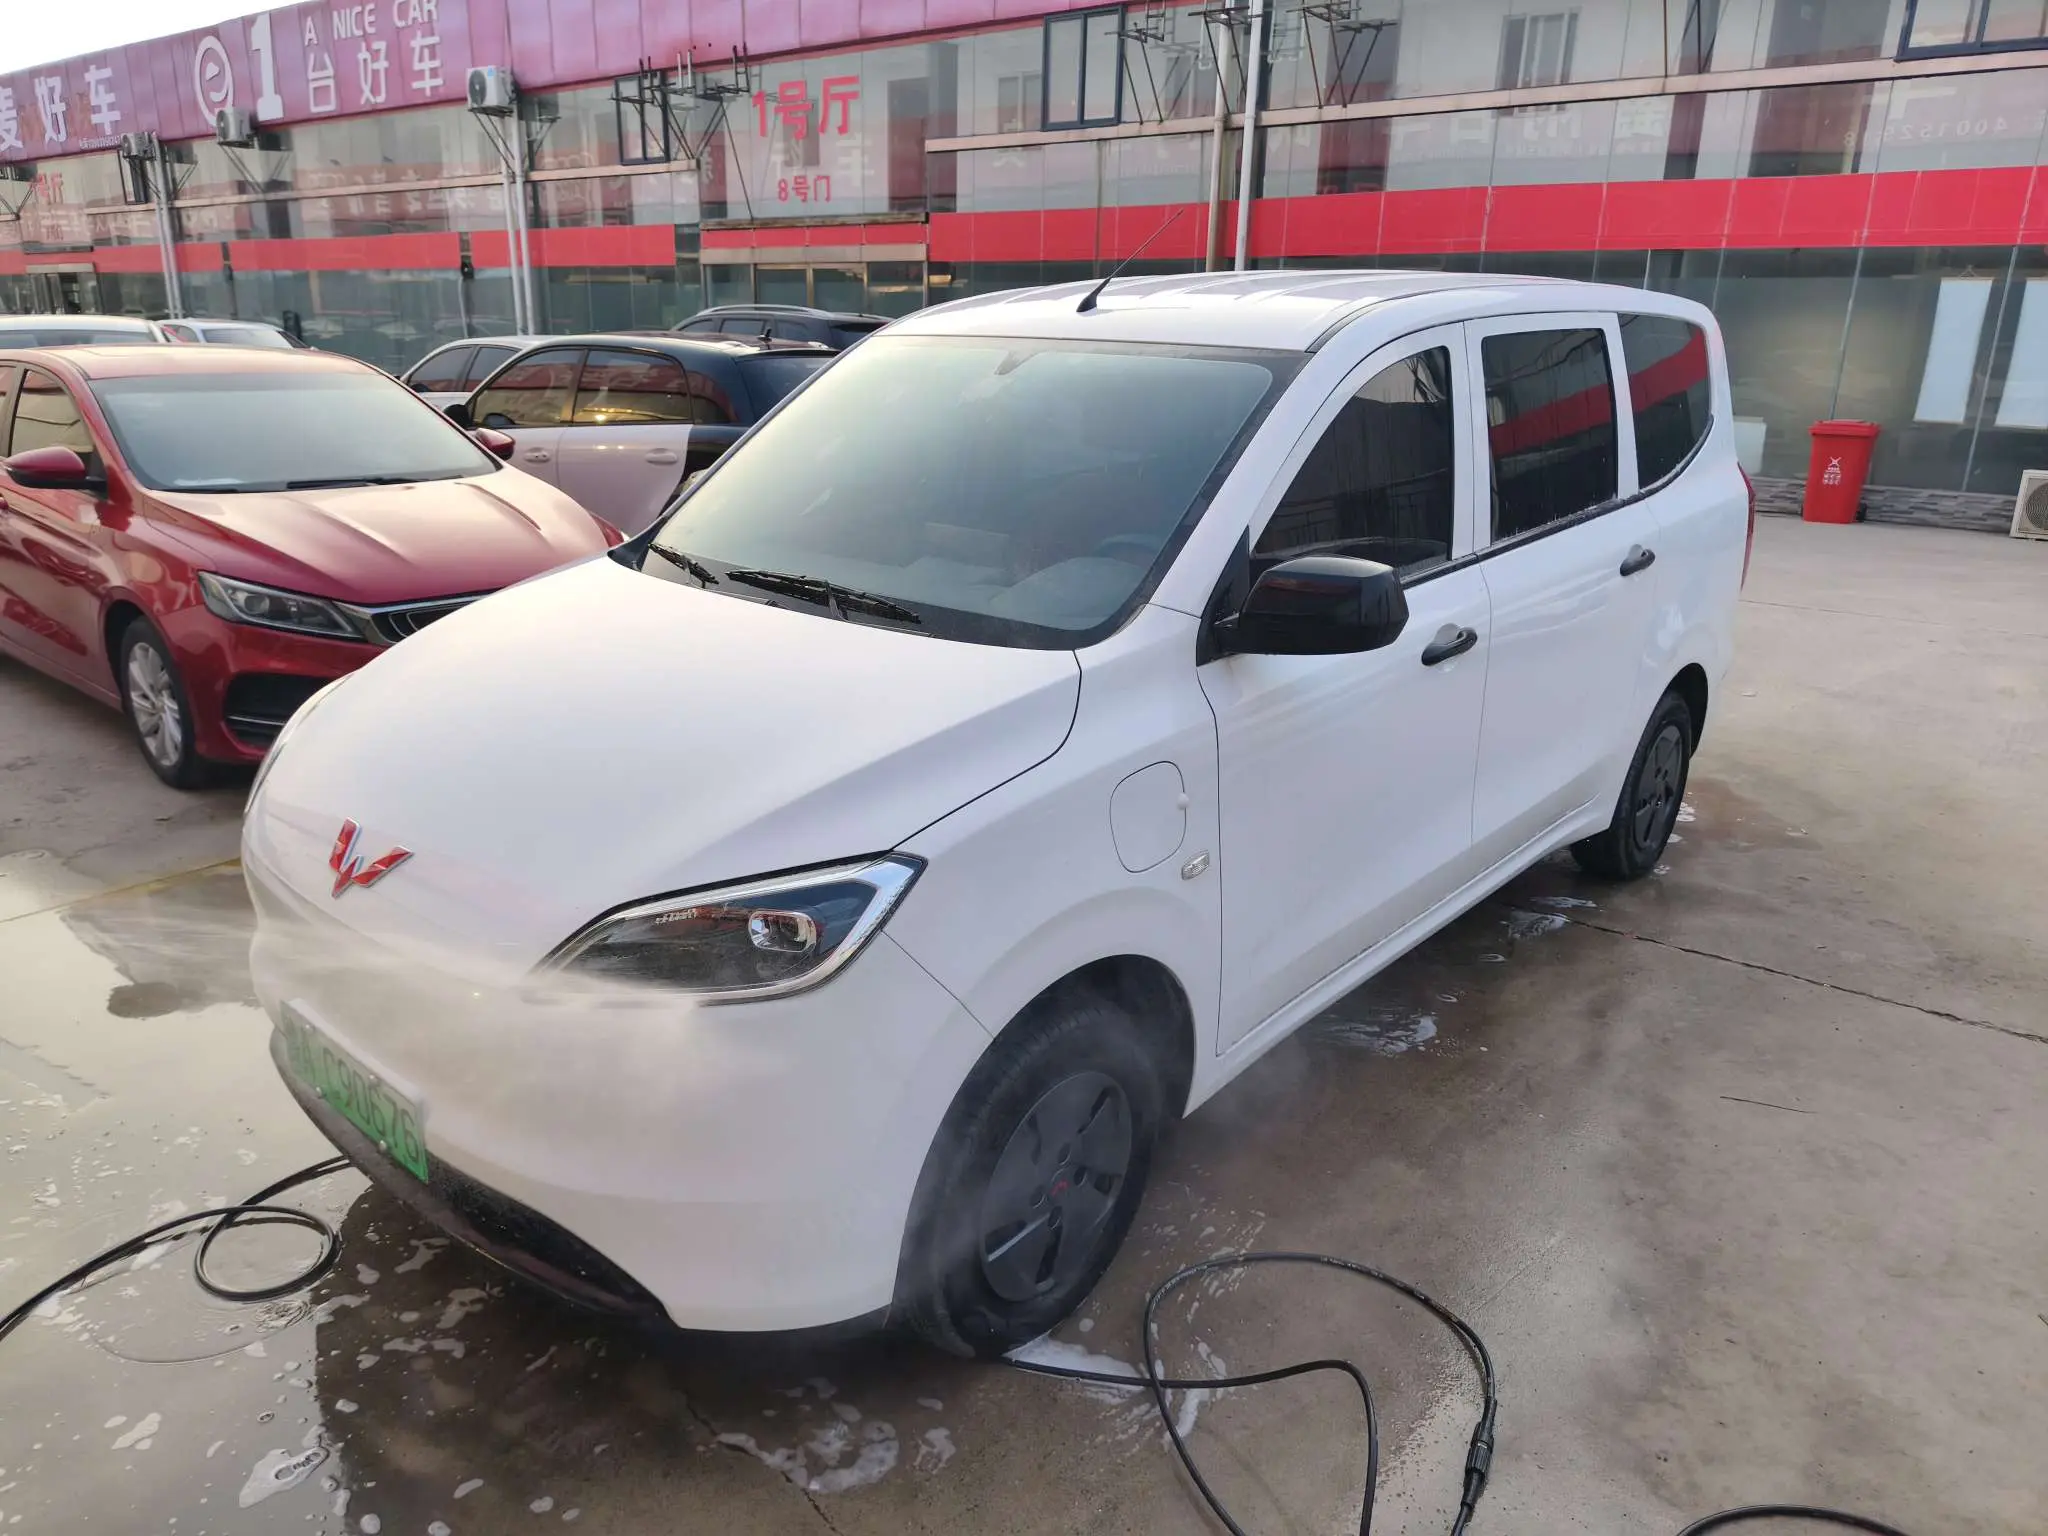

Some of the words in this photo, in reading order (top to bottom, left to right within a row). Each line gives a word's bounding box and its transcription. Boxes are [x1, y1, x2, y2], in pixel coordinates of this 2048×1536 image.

[304, 16, 318, 46] A
[333, 4, 376, 40] NICE
[393, 0, 438, 28] CAR
[752, 75, 860, 141] 1号厅
[777, 176, 831, 203] 8号门
